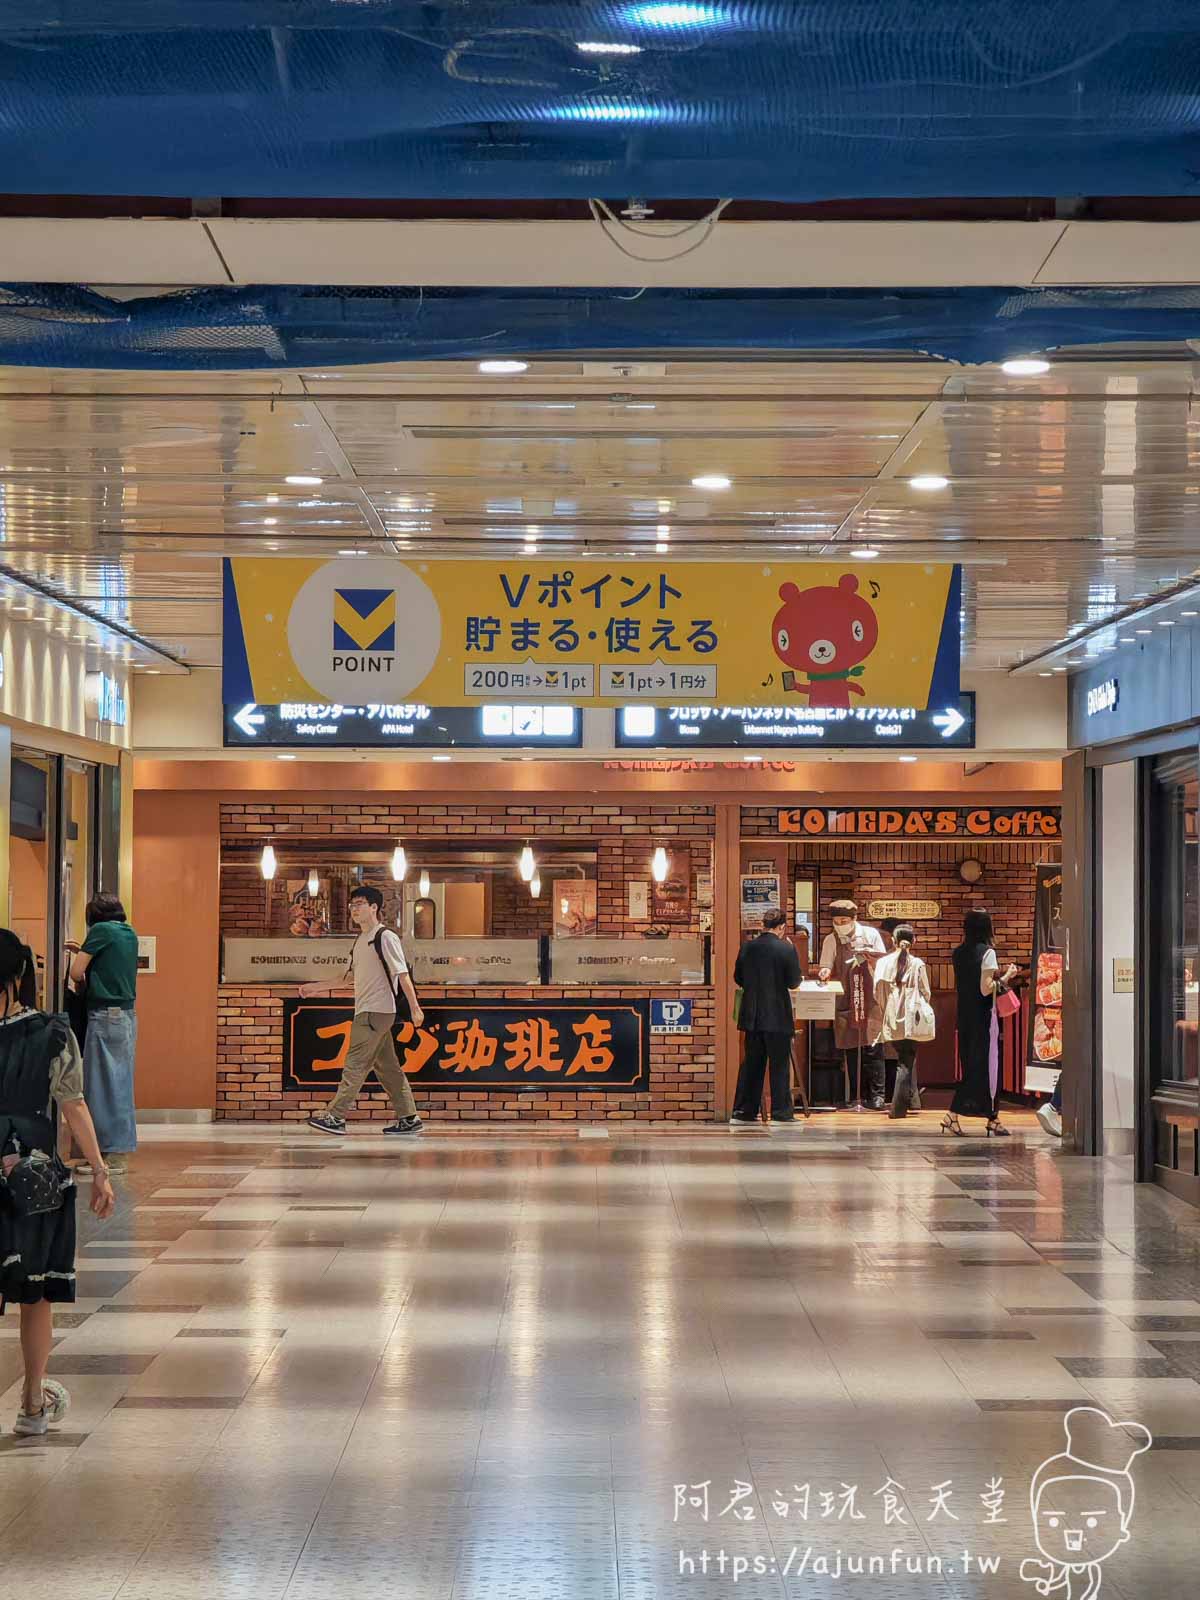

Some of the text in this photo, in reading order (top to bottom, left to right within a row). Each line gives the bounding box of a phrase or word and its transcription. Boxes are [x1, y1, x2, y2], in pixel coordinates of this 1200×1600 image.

[499, 570, 682, 609] Vポイント
[465, 616, 718, 653] 貯まる・使える
[333, 657, 395, 672] POINT
[966, 809, 1061, 834] Coffe
[311, 1013, 615, 1076] コダ珈琲店
